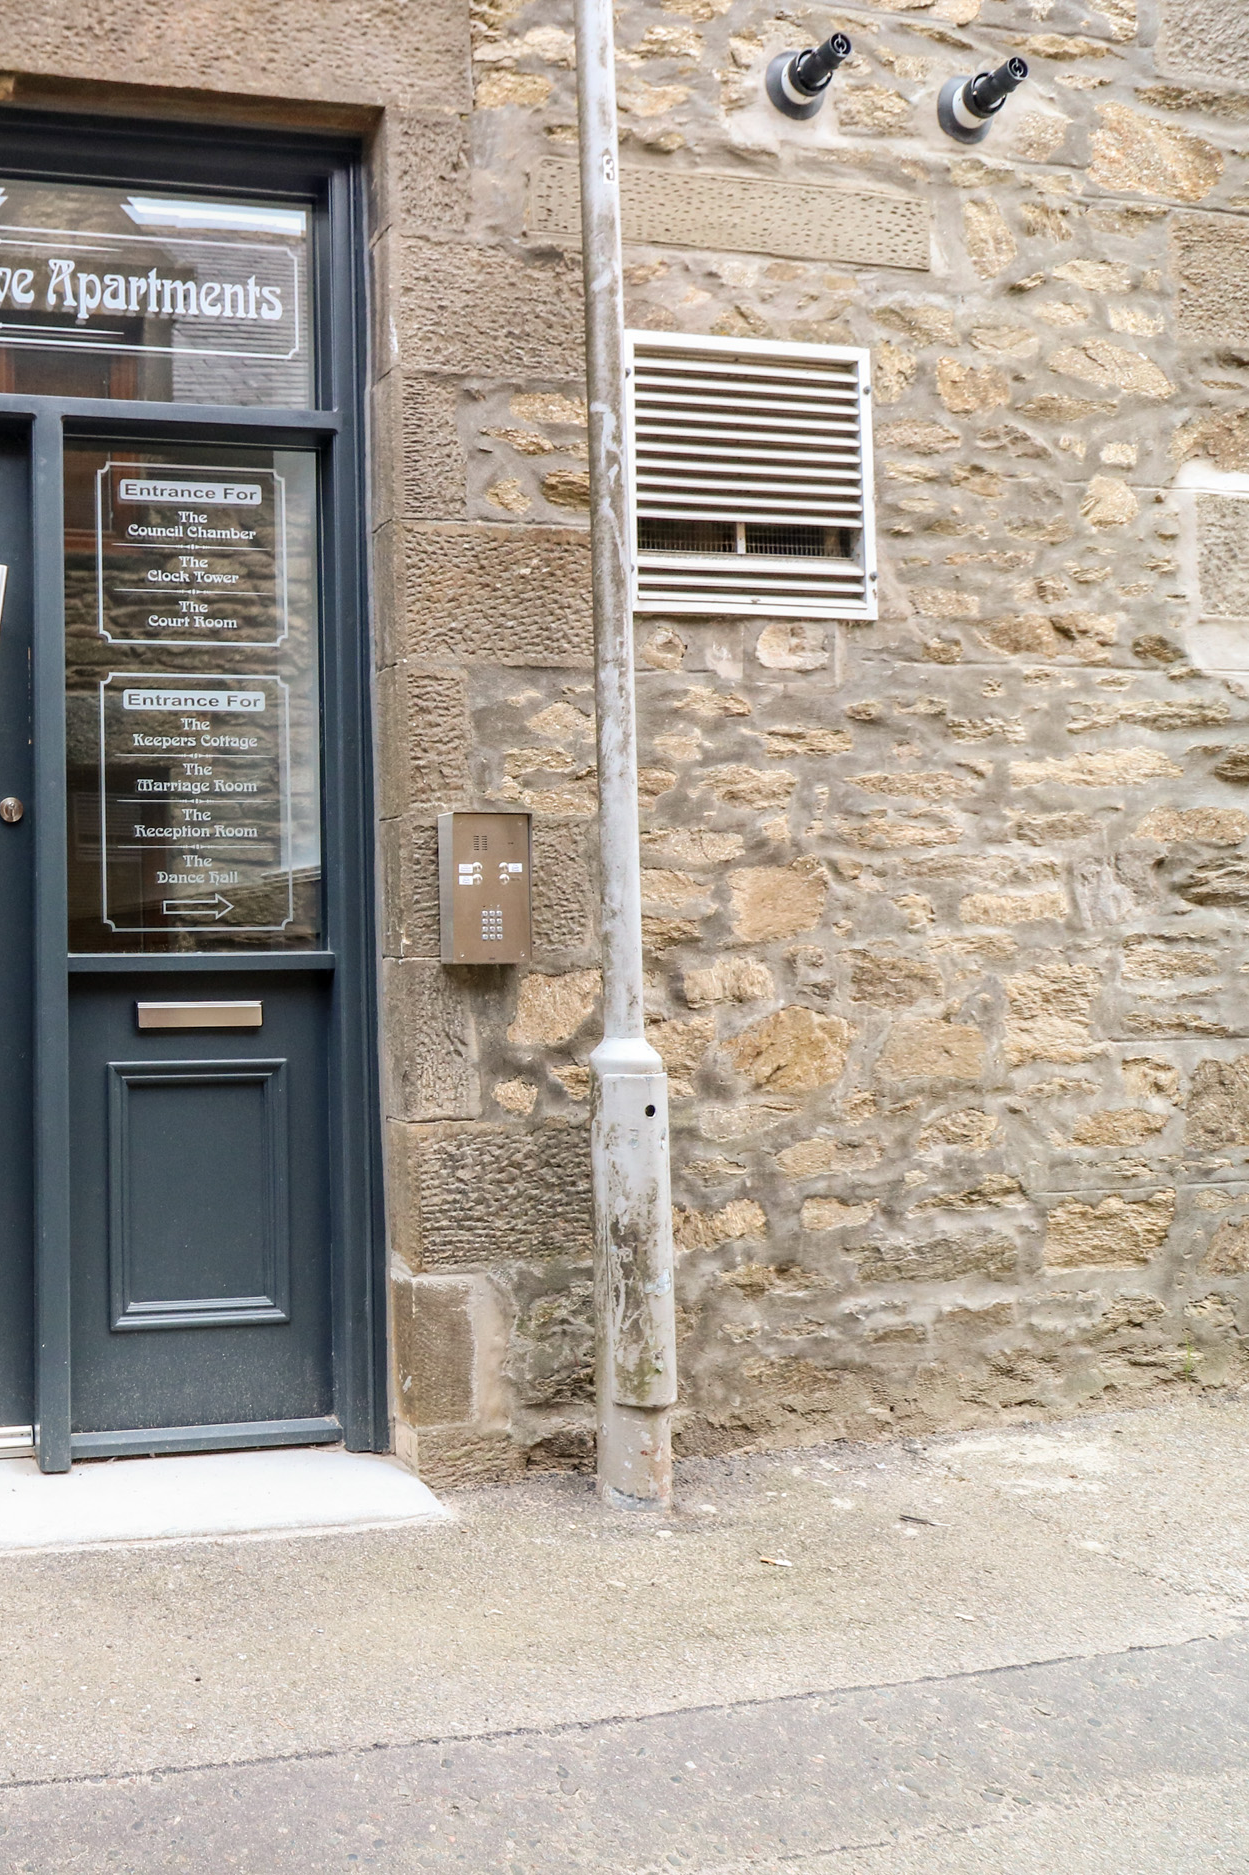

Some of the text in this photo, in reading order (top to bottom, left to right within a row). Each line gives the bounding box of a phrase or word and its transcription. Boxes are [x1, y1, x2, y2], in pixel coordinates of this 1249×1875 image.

[605, 158, 615, 180] 3
[47, 258, 284, 324] Apartments
[125, 483, 258, 500] Entrance For
[178, 511, 208, 524] The
[127, 524, 257, 540] Council Chamber
[178, 555, 208, 568] The
[147, 569, 239, 584] Clock Tower
[178, 600, 208, 613] The
[148, 614, 238, 629] Court Room
[127, 693, 261, 708] Entrance For
[180, 717, 210, 731] The
[132, 733, 258, 748] Keepers Cottage
[183, 763, 212, 776] The
[136, 778, 257, 794] Marriage Room
[181, 808, 211, 821] The
[134, 824, 258, 839] Reception Room
[183, 854, 212, 867] The
[157, 871, 239, 886] Dance Hall
